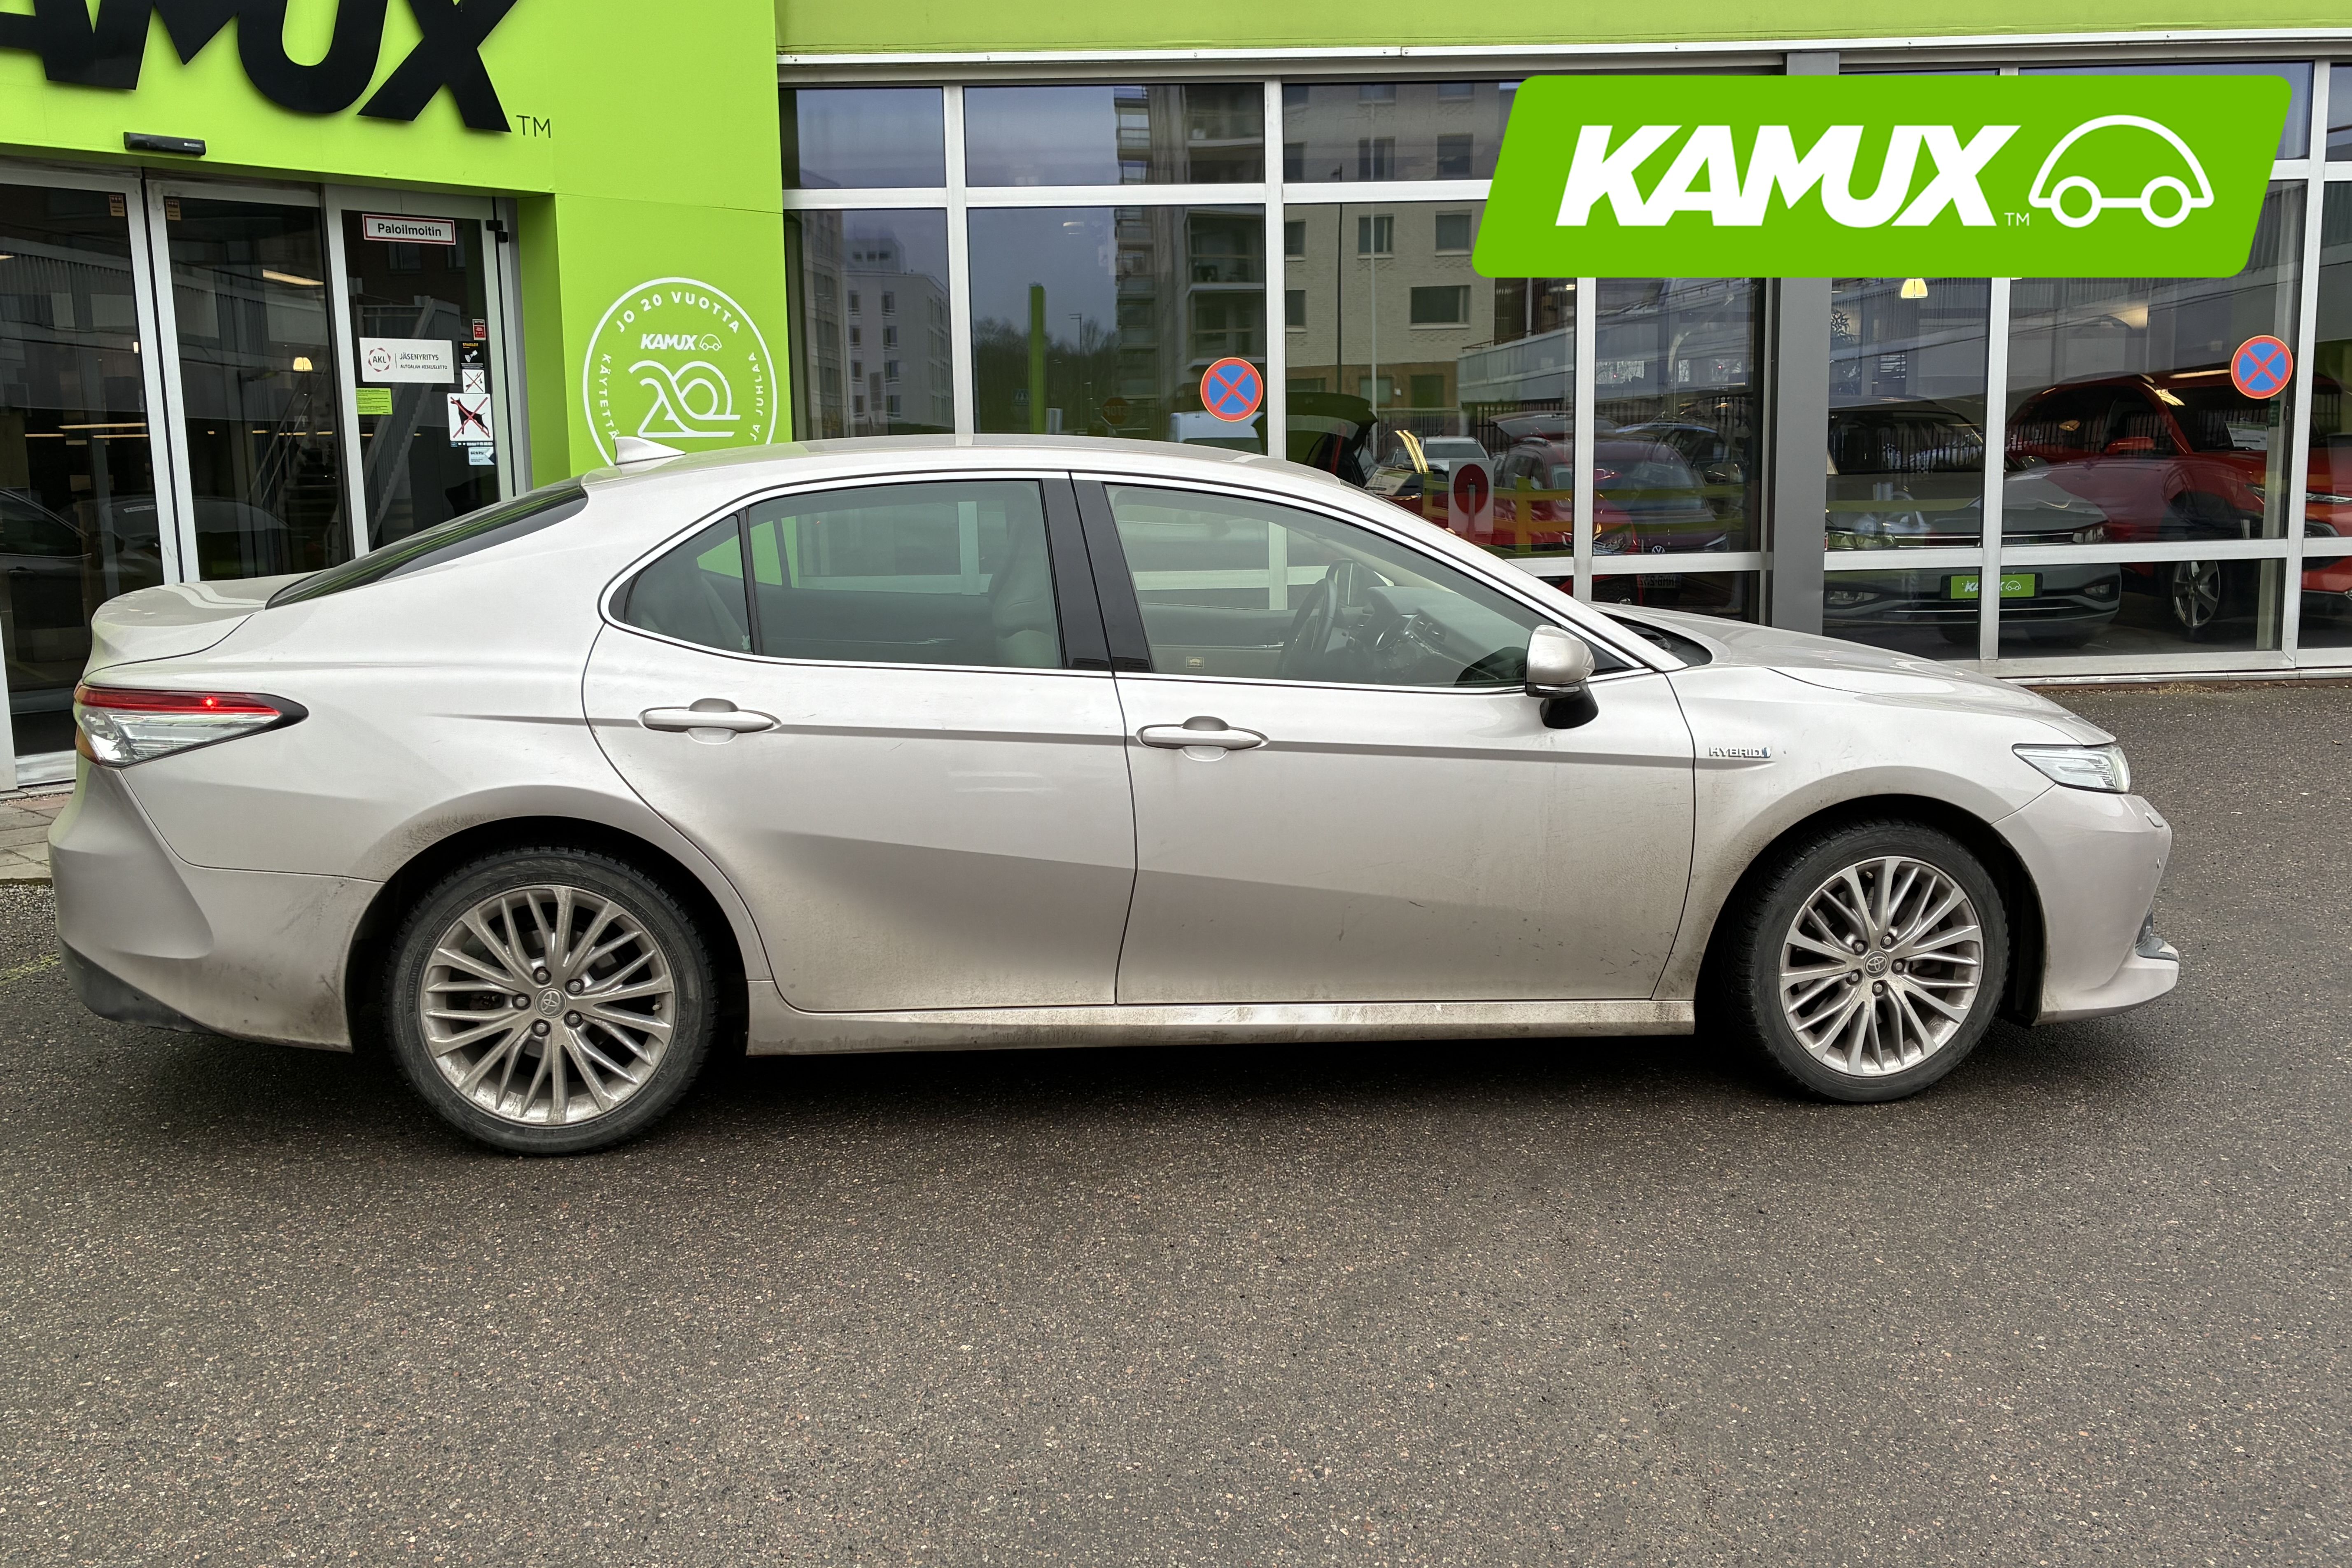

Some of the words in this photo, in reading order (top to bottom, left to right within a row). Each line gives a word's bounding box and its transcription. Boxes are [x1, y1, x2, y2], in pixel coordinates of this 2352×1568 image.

[516, 115, 551, 139] TM
[378, 223, 441, 237] Paloilmoitin
[616, 310, 635, 333] JO
[640, 294, 663, 312] 20
[671, 291, 740, 334] VUOTTA
[641, 334, 698, 350] KAMUX
[399, 352, 439, 361] JÄSENYRITYS
[748, 352, 765, 416] JUHLAA
[599, 353, 620, 440] KÄYTETTÄ
[750, 424, 761, 441] JA
[1709, 746, 1762, 758] HYBRID
